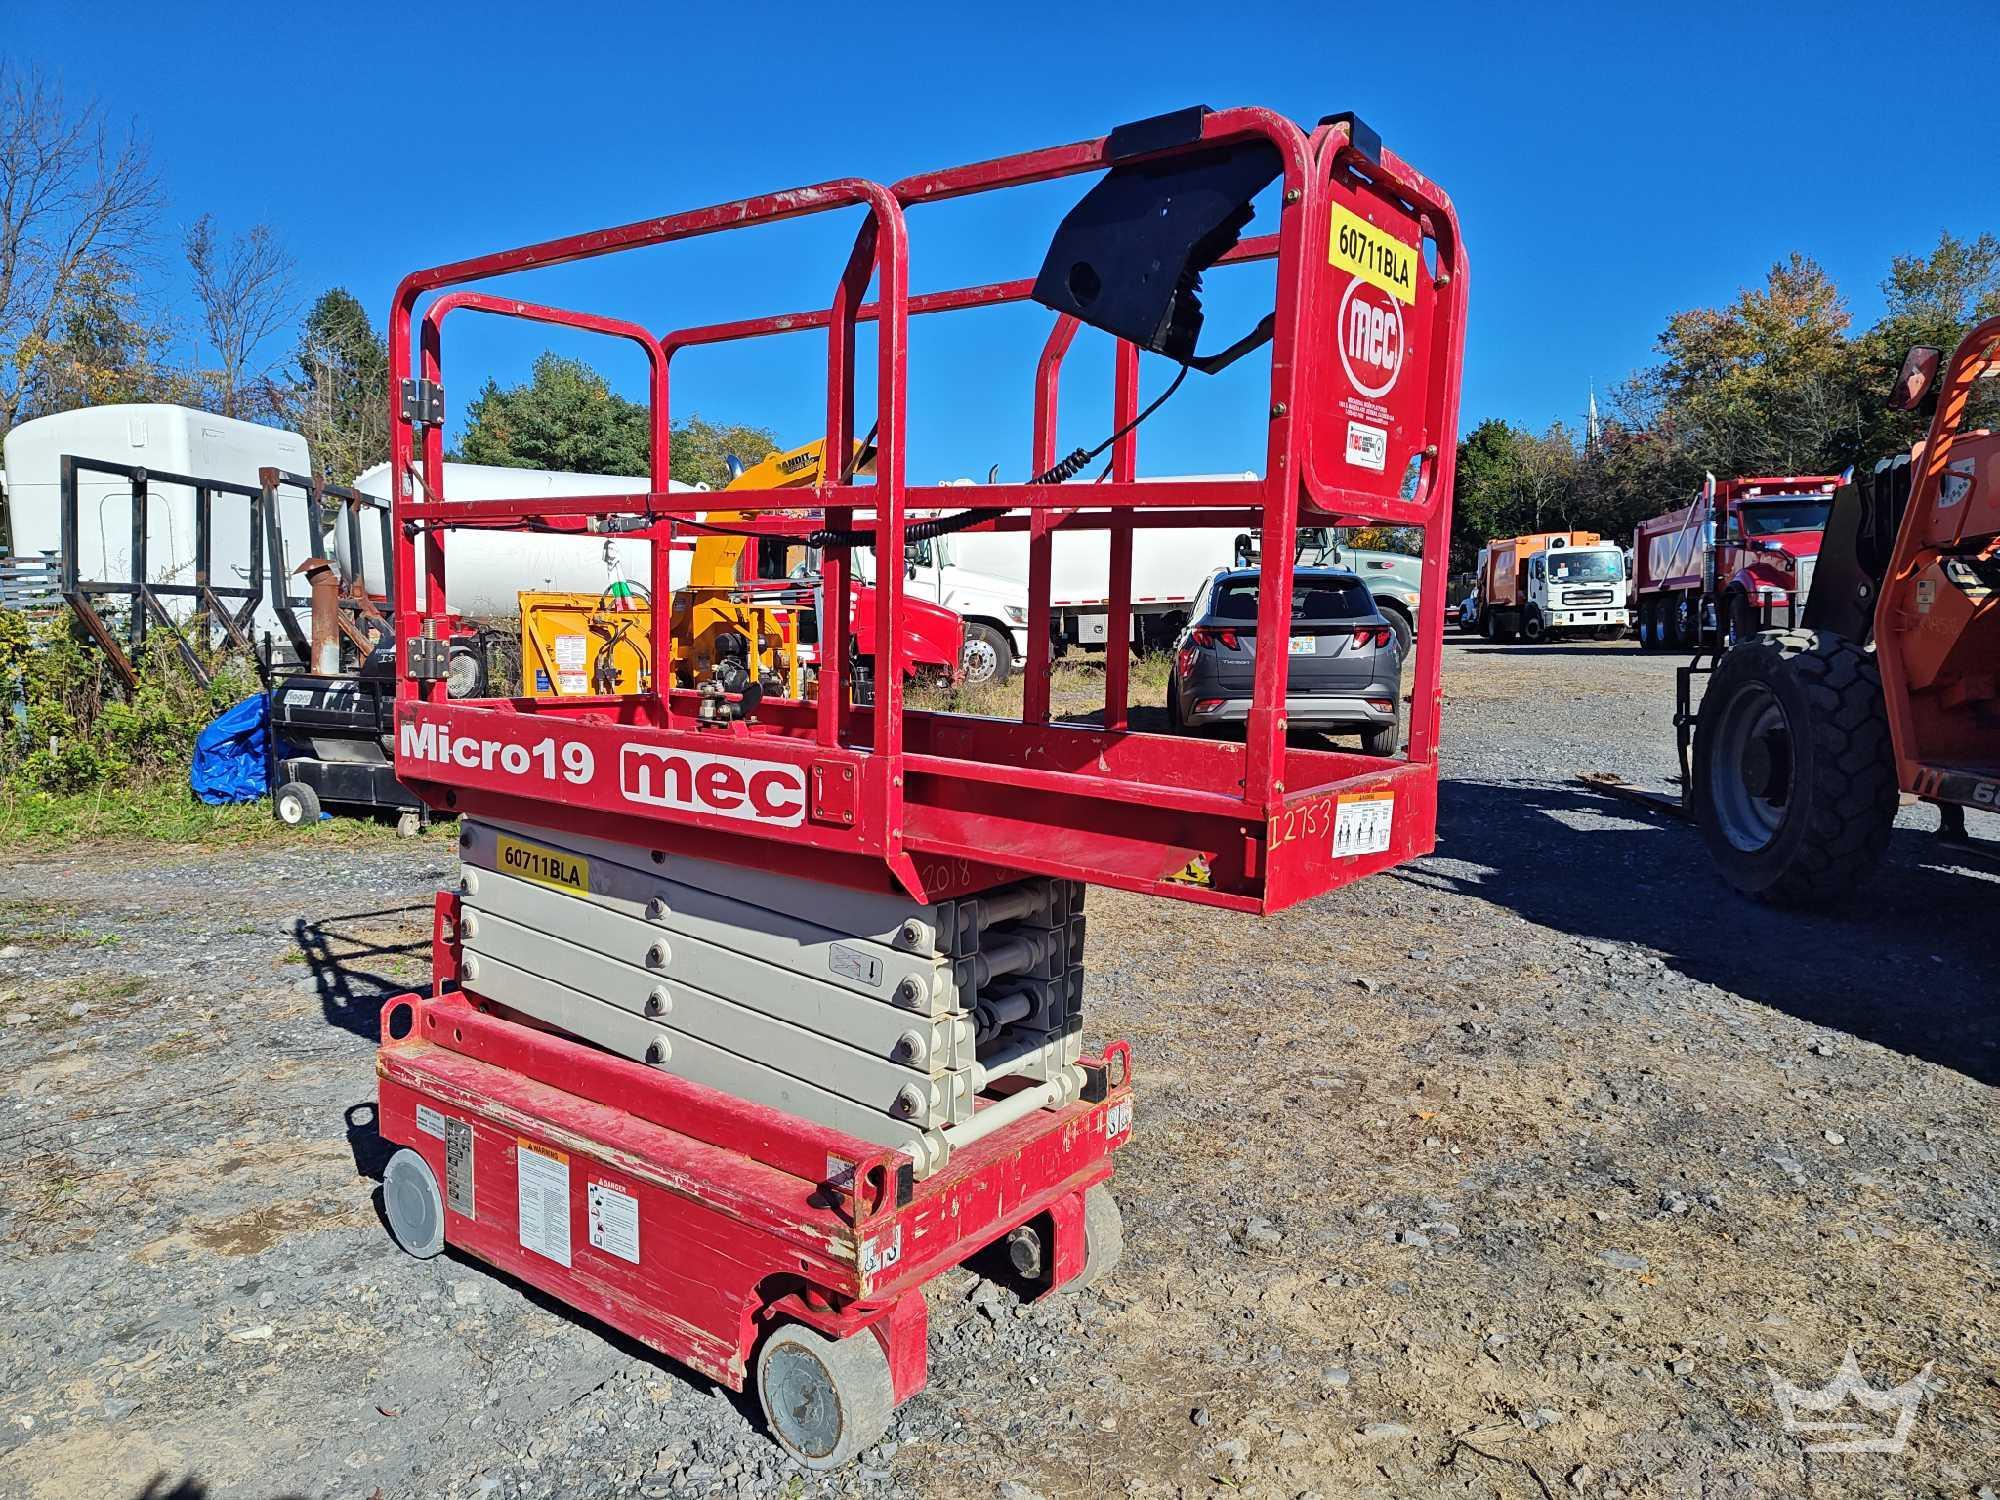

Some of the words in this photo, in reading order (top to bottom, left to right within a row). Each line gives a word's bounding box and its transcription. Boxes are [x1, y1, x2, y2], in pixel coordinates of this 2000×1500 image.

[1339, 224, 1409, 289] 60711BLA
[1348, 298, 1397, 370] mec
[400, 722, 595, 785] Micro19
[624, 749, 803, 819] mec
[504, 846, 581, 888] 60711BLA
[922, 857, 971, 895] 2018
[533, 1145, 560, 1160] WARNING
[603, 1181, 627, 1194] DANGER
